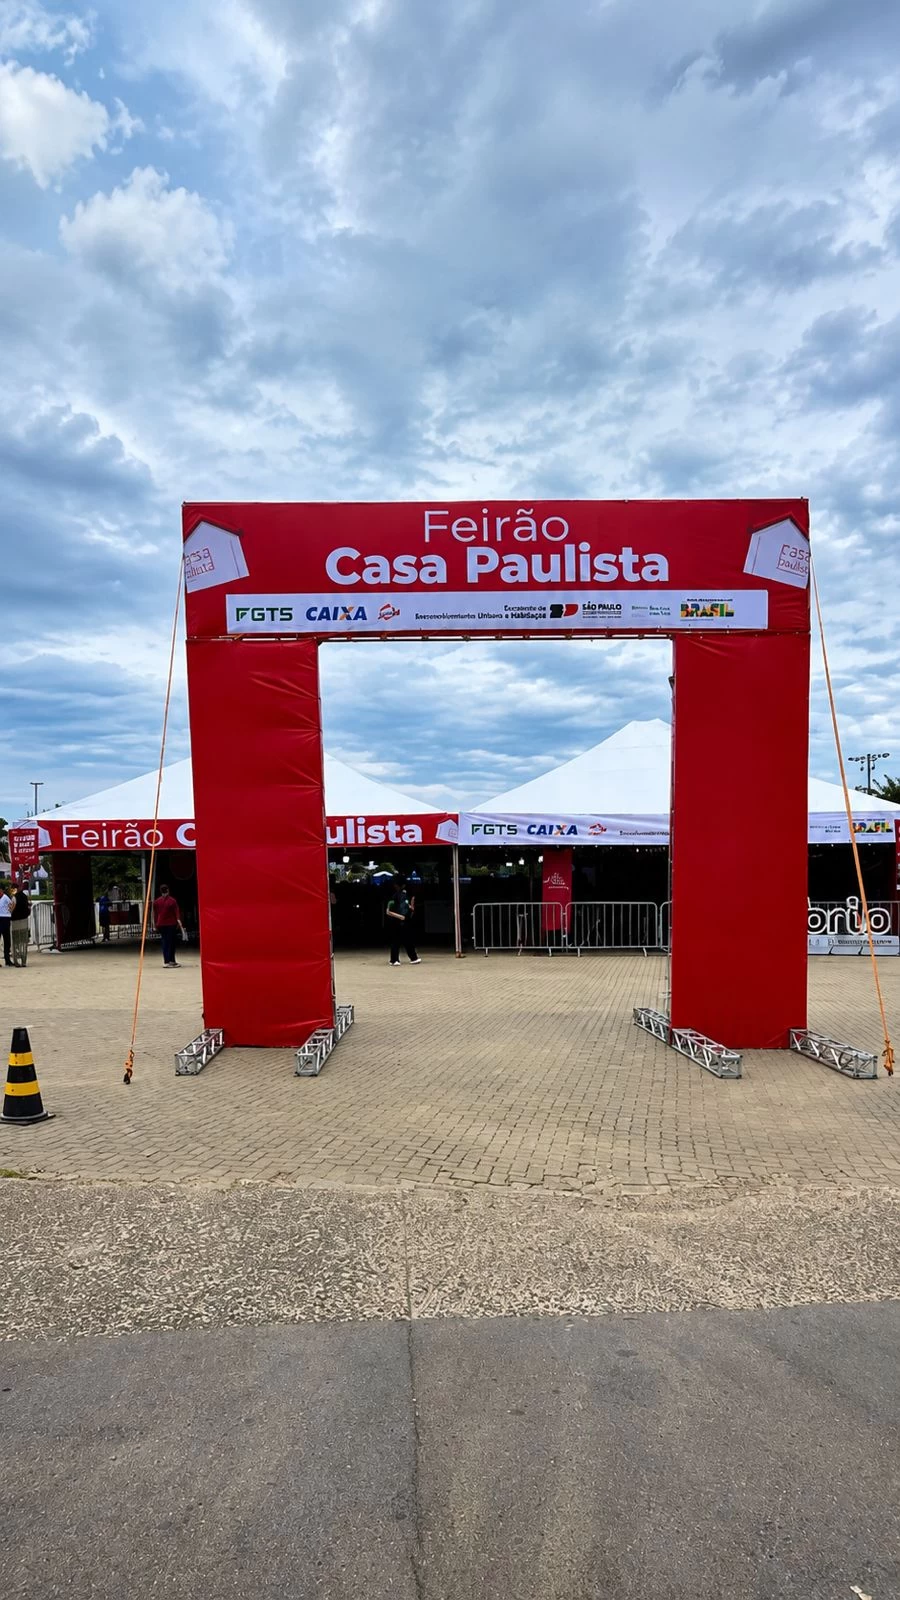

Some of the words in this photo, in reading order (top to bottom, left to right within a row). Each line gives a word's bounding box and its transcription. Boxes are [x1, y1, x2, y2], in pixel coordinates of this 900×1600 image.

[424, 508, 569, 543] Feirão
[325, 546, 448, 585] Casa
[466, 541, 669, 584] Paulista
[777, 558, 809, 575] paulist
[235, 607, 293, 621] FGTS
[305, 606, 368, 621] CAIXA
[598, 603, 622, 611] PAULO
[680, 603, 734, 618] BRASIL
[62, 822, 163, 848] Feirão
[326, 817, 423, 844] ulista
[471, 823, 518, 835] FGTS
[527, 824, 578, 836] CAIXA
